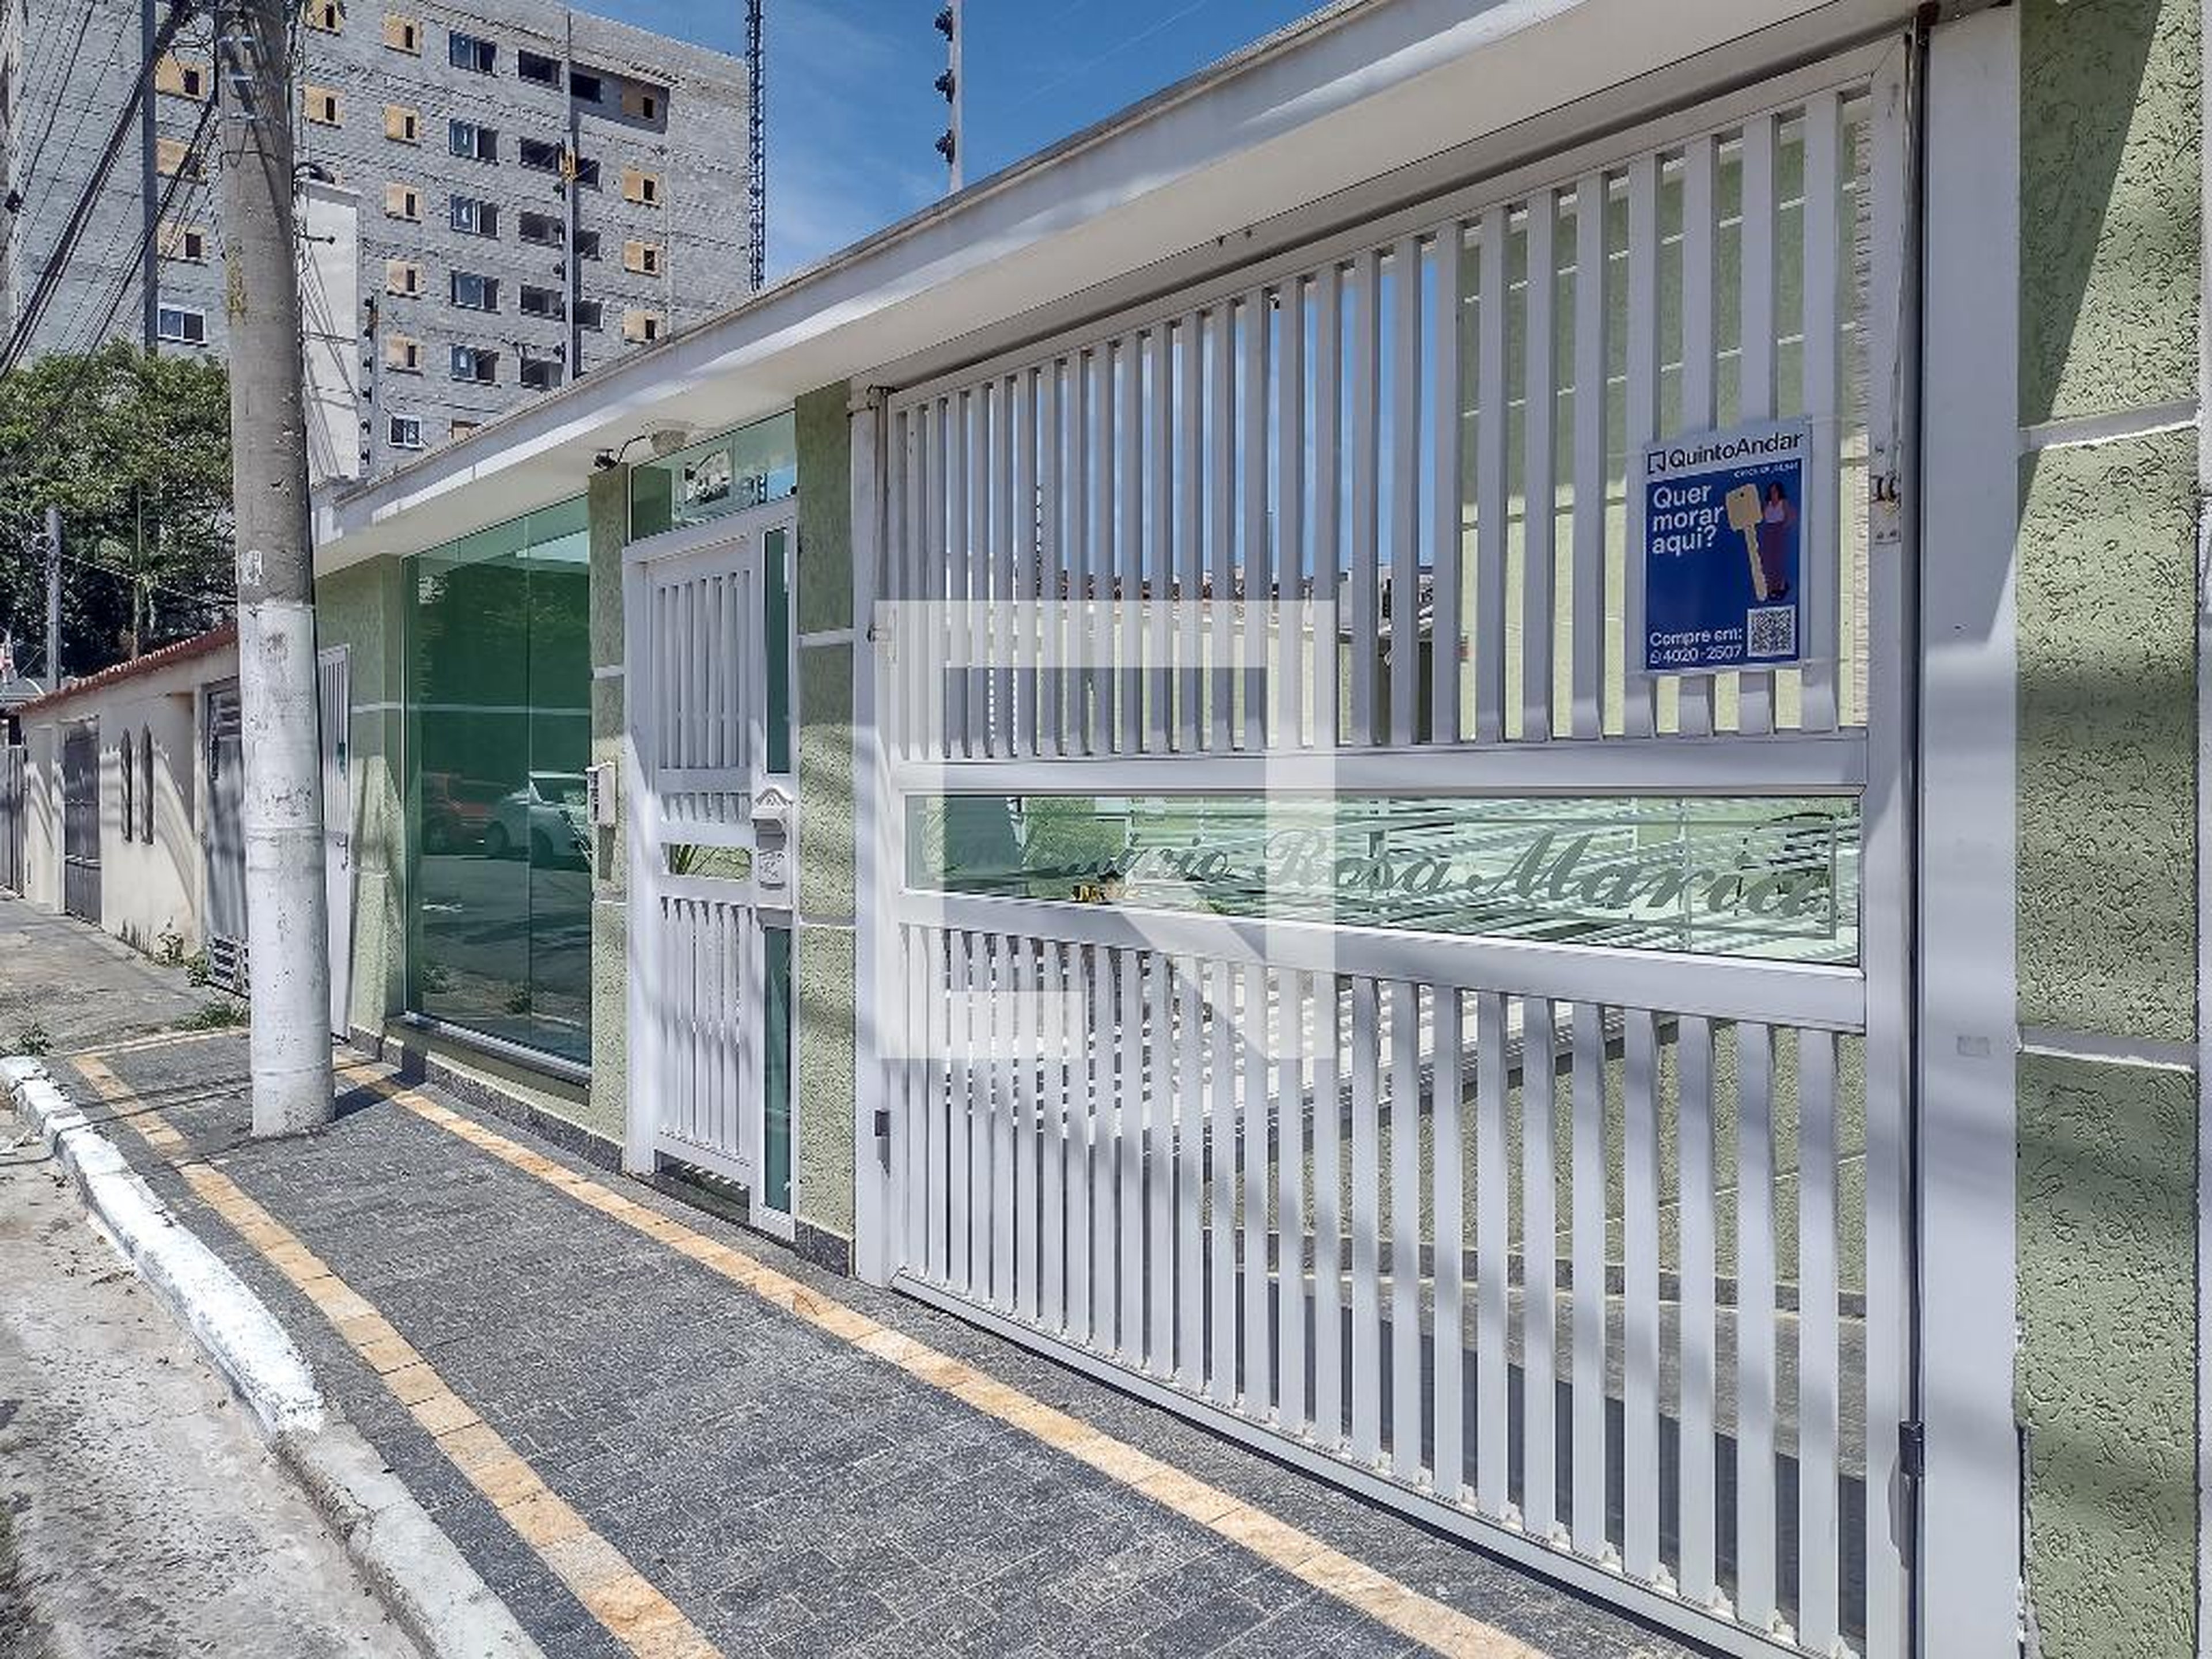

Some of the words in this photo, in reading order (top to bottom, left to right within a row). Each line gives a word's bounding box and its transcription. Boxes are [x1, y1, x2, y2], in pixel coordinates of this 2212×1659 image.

[1669, 433, 1803, 468] QuintoAndar
[1653, 486, 1711, 508] Quer
[1653, 506, 1724, 532] morar
[1652, 524, 1717, 556] aqui?
[1650, 630, 1711, 646] Compre
[1714, 627, 1742, 642] em:
[1263, 828, 1452, 896] Rosa
[1466, 830, 1832, 916] Maria
